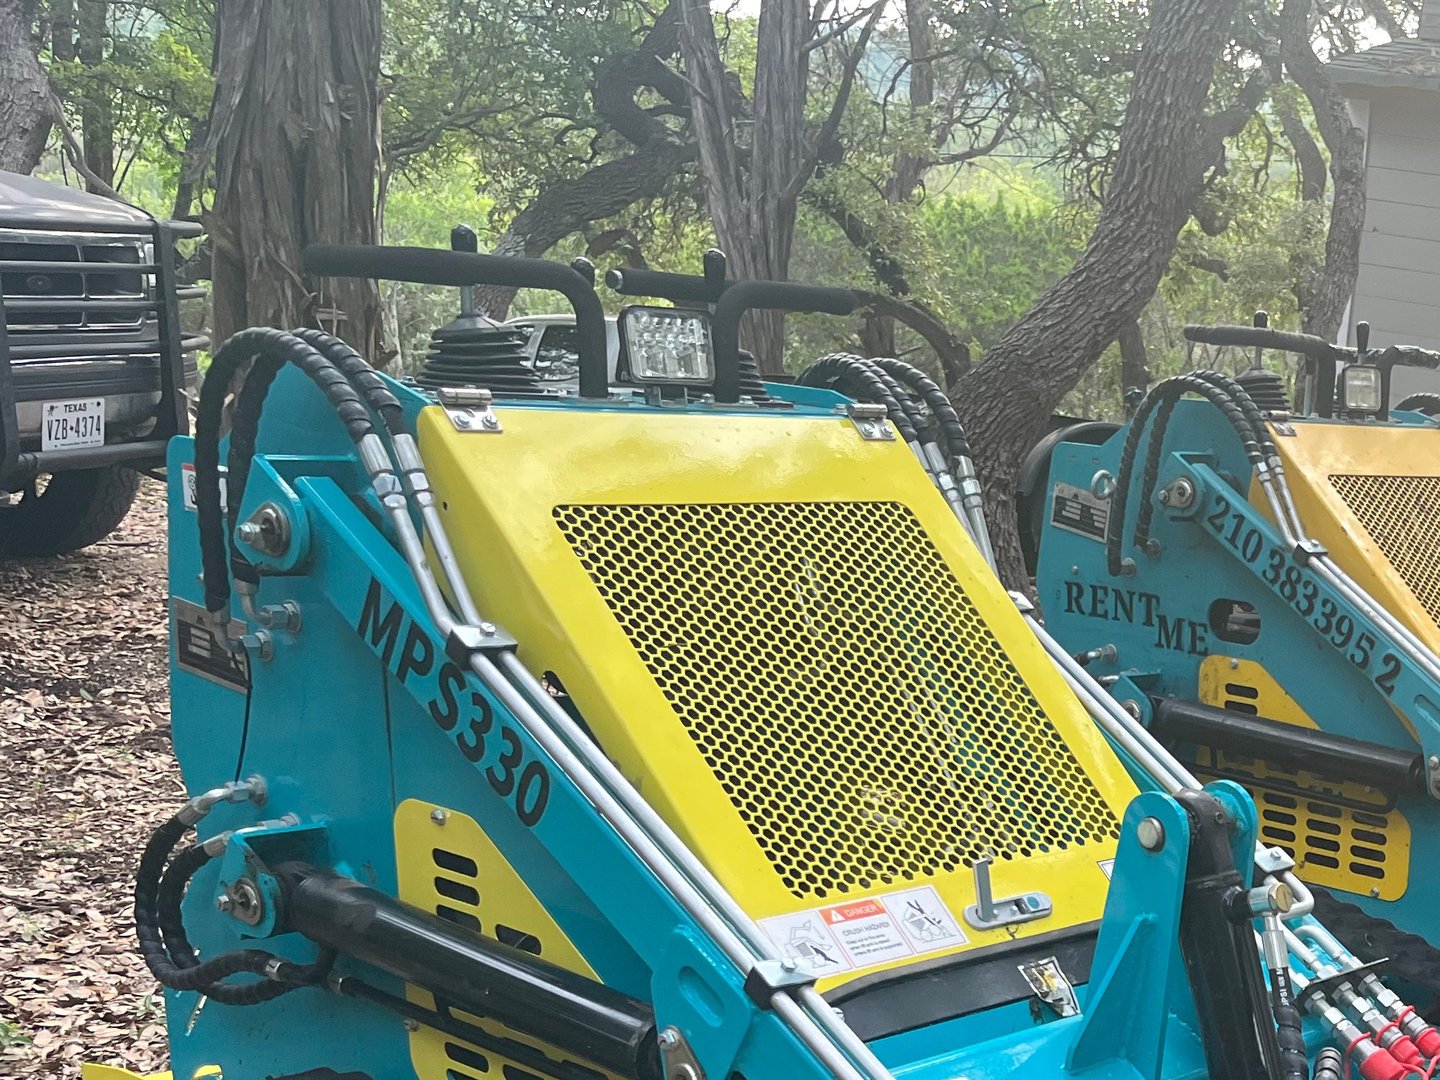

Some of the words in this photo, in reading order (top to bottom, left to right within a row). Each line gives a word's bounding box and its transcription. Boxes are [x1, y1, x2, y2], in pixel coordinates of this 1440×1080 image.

[64, 403, 87, 413] TEXAS
[1064, 580, 1160, 627] RENT
[1155, 614, 1209, 656] ME
[357, 576, 550, 828] MPS330
